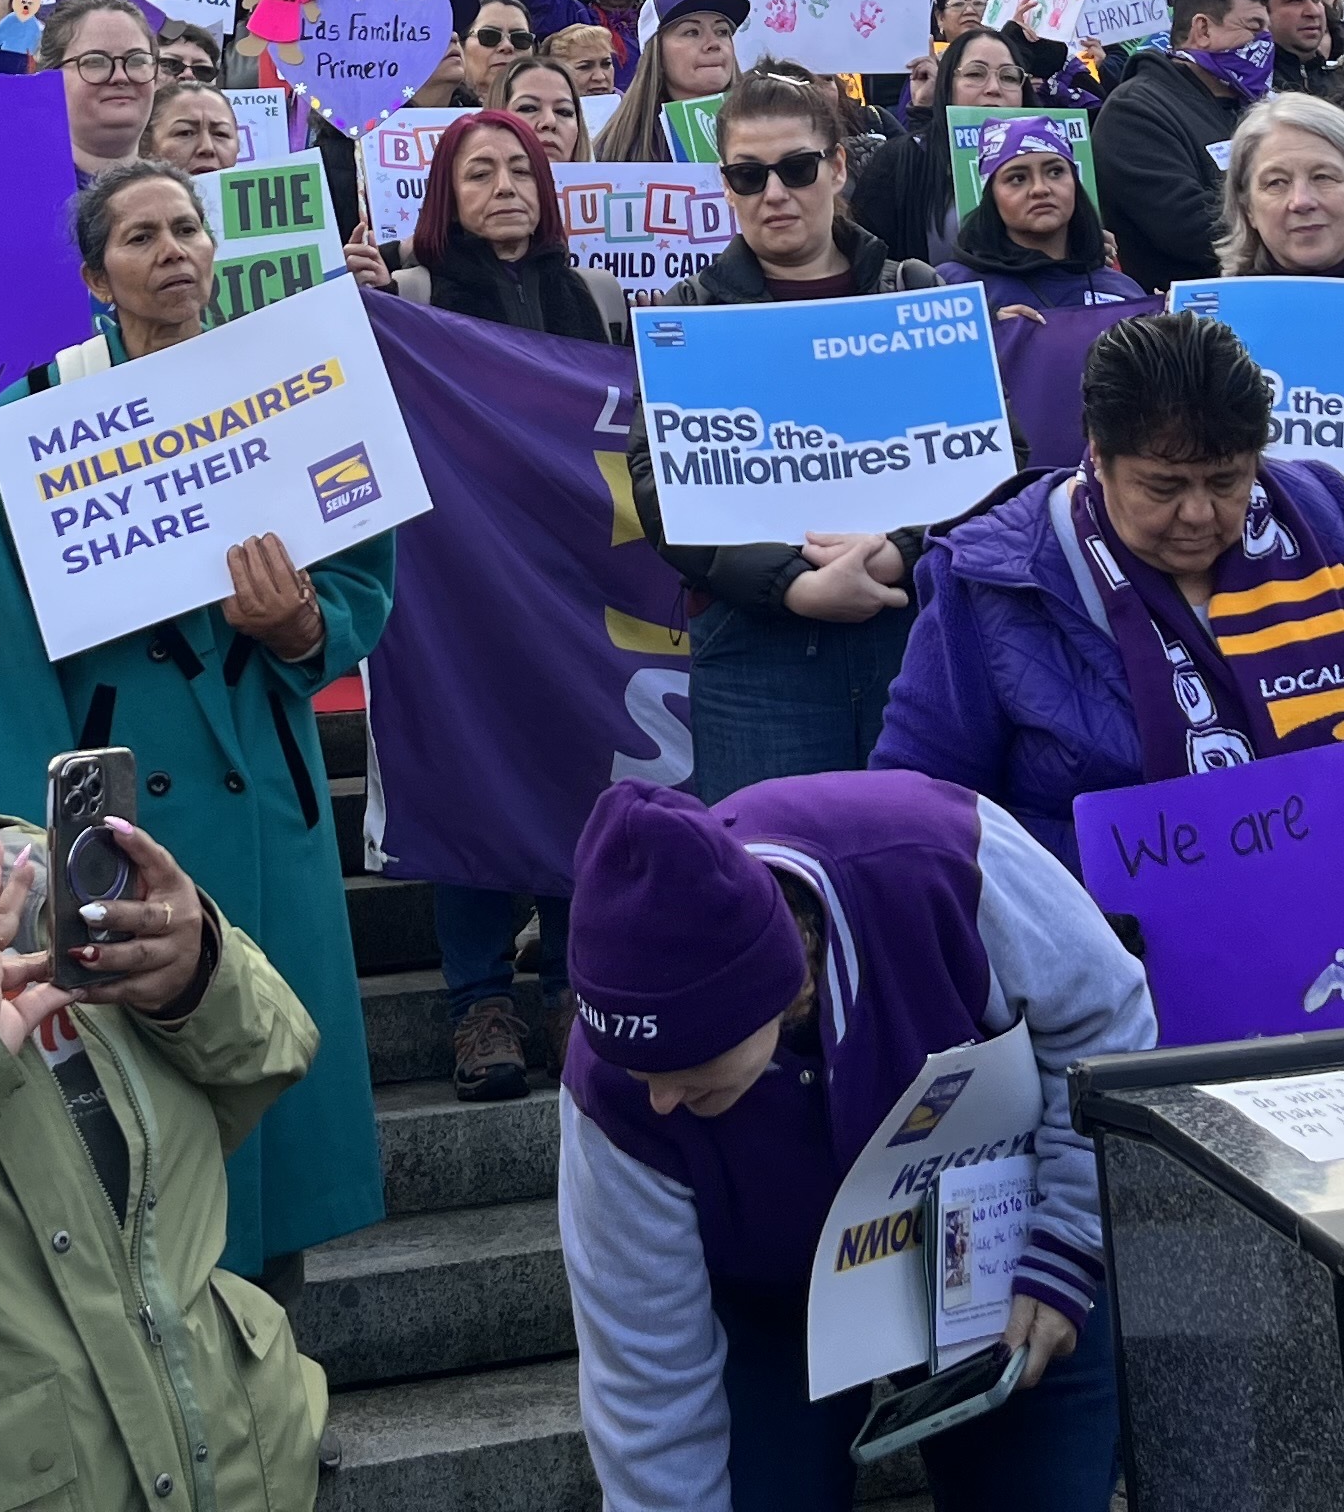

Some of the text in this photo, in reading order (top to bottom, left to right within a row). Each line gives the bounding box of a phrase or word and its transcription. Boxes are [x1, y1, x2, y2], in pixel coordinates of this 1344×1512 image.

[299, 12, 431, 43] Las Familias
[317, 52, 399, 80] Primero
[1069, 120, 1084, 139] AI
[229, 172, 314, 232] THE
[588, 252, 656, 279] CHILD
[896, 296, 974, 326] FUND
[812, 320, 979, 361] EDUCATION
[1292, 389, 1344, 416] the
[27, 396, 155, 462] MAKE
[38, 362, 333, 501] MILLIONAIRES
[653, 408, 757, 444] Pass
[773, 425, 824, 450] the
[659, 424, 1003, 486] Millionaires Tax
[50, 436, 272, 538] PAY THEIR
[324, 481, 374, 515] SEIU 775
[61, 502, 211, 575] SHARE
[1111, 795, 1312, 879] We are
[611, 1013, 658, 1041] 775
[1251, 1095, 1278, 1110] do
[1268, 1105, 1328, 1123] make
[1289, 1121, 1335, 1138] pay
